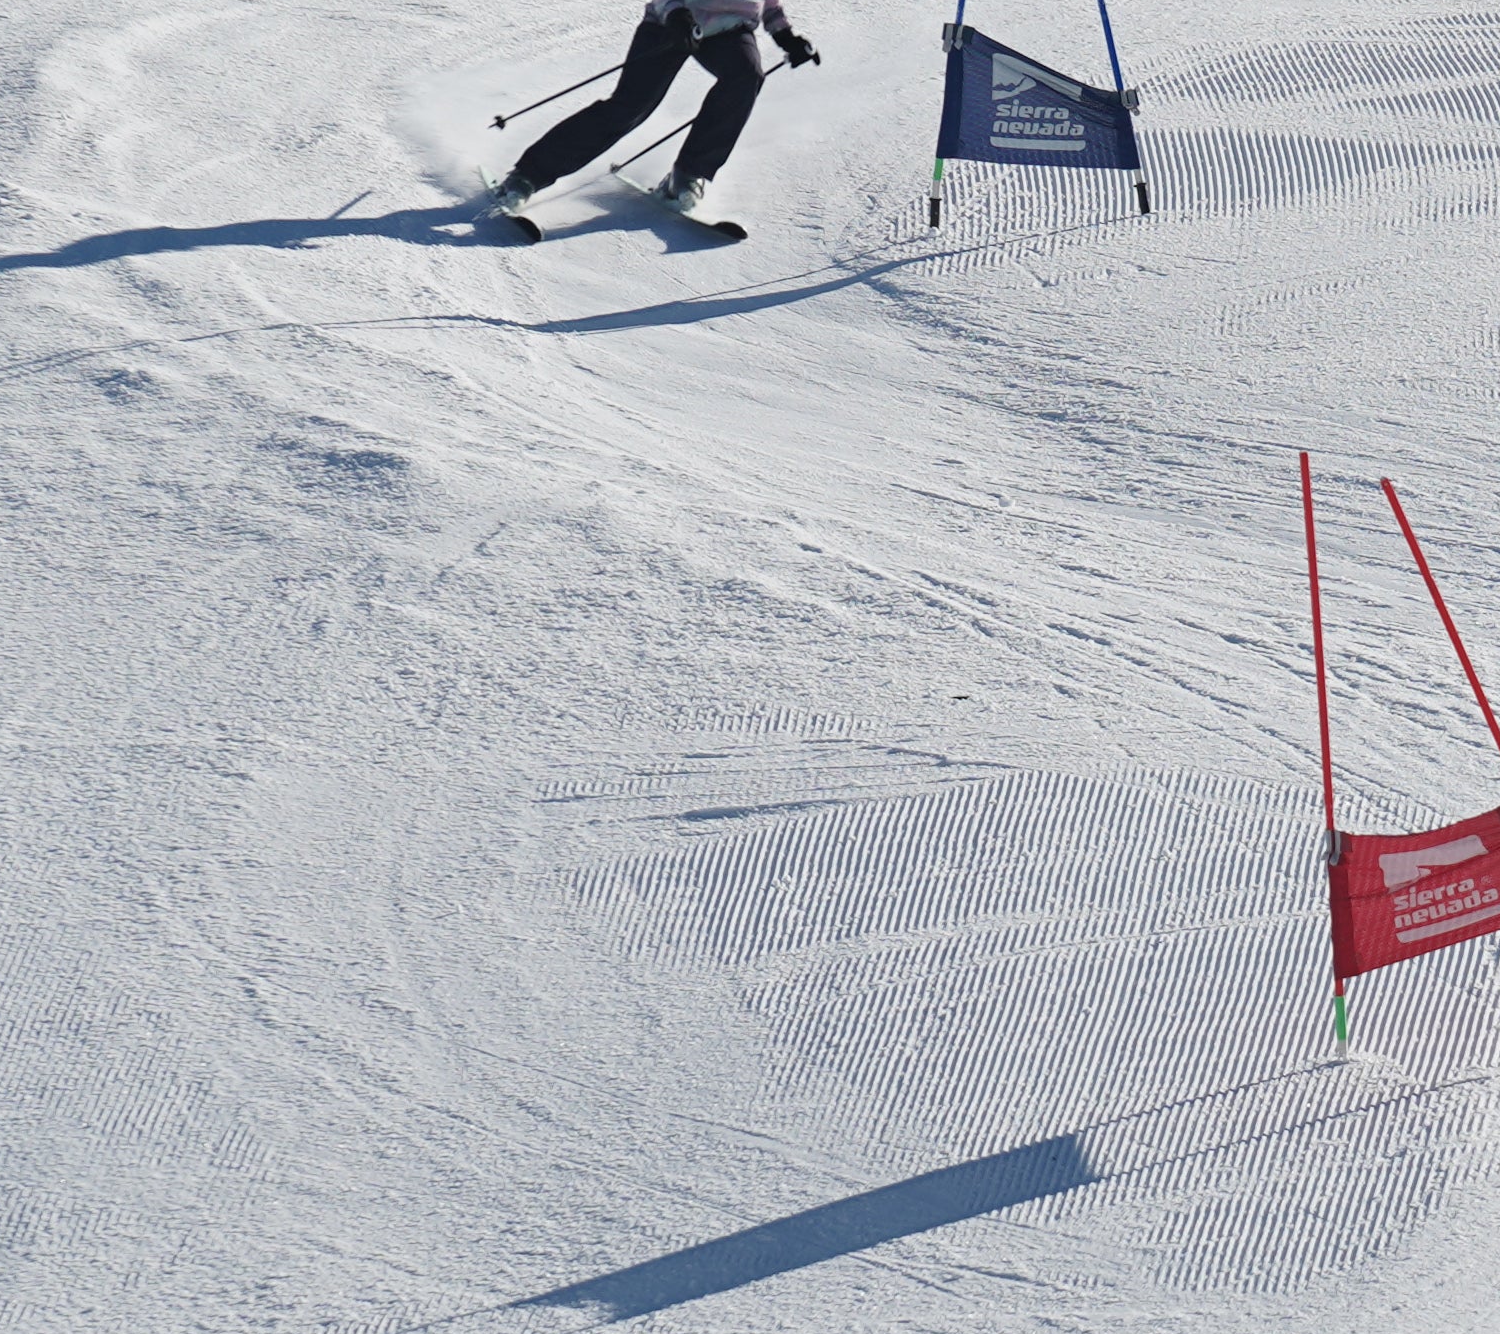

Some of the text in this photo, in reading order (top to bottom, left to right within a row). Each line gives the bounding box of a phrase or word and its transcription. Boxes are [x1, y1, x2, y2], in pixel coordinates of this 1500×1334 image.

[995, 99, 1069, 120] sierra
[992, 120, 1084, 136] nevada
[1393, 877, 1475, 912] sierra
[1394, 887, 1499, 930] nevada
